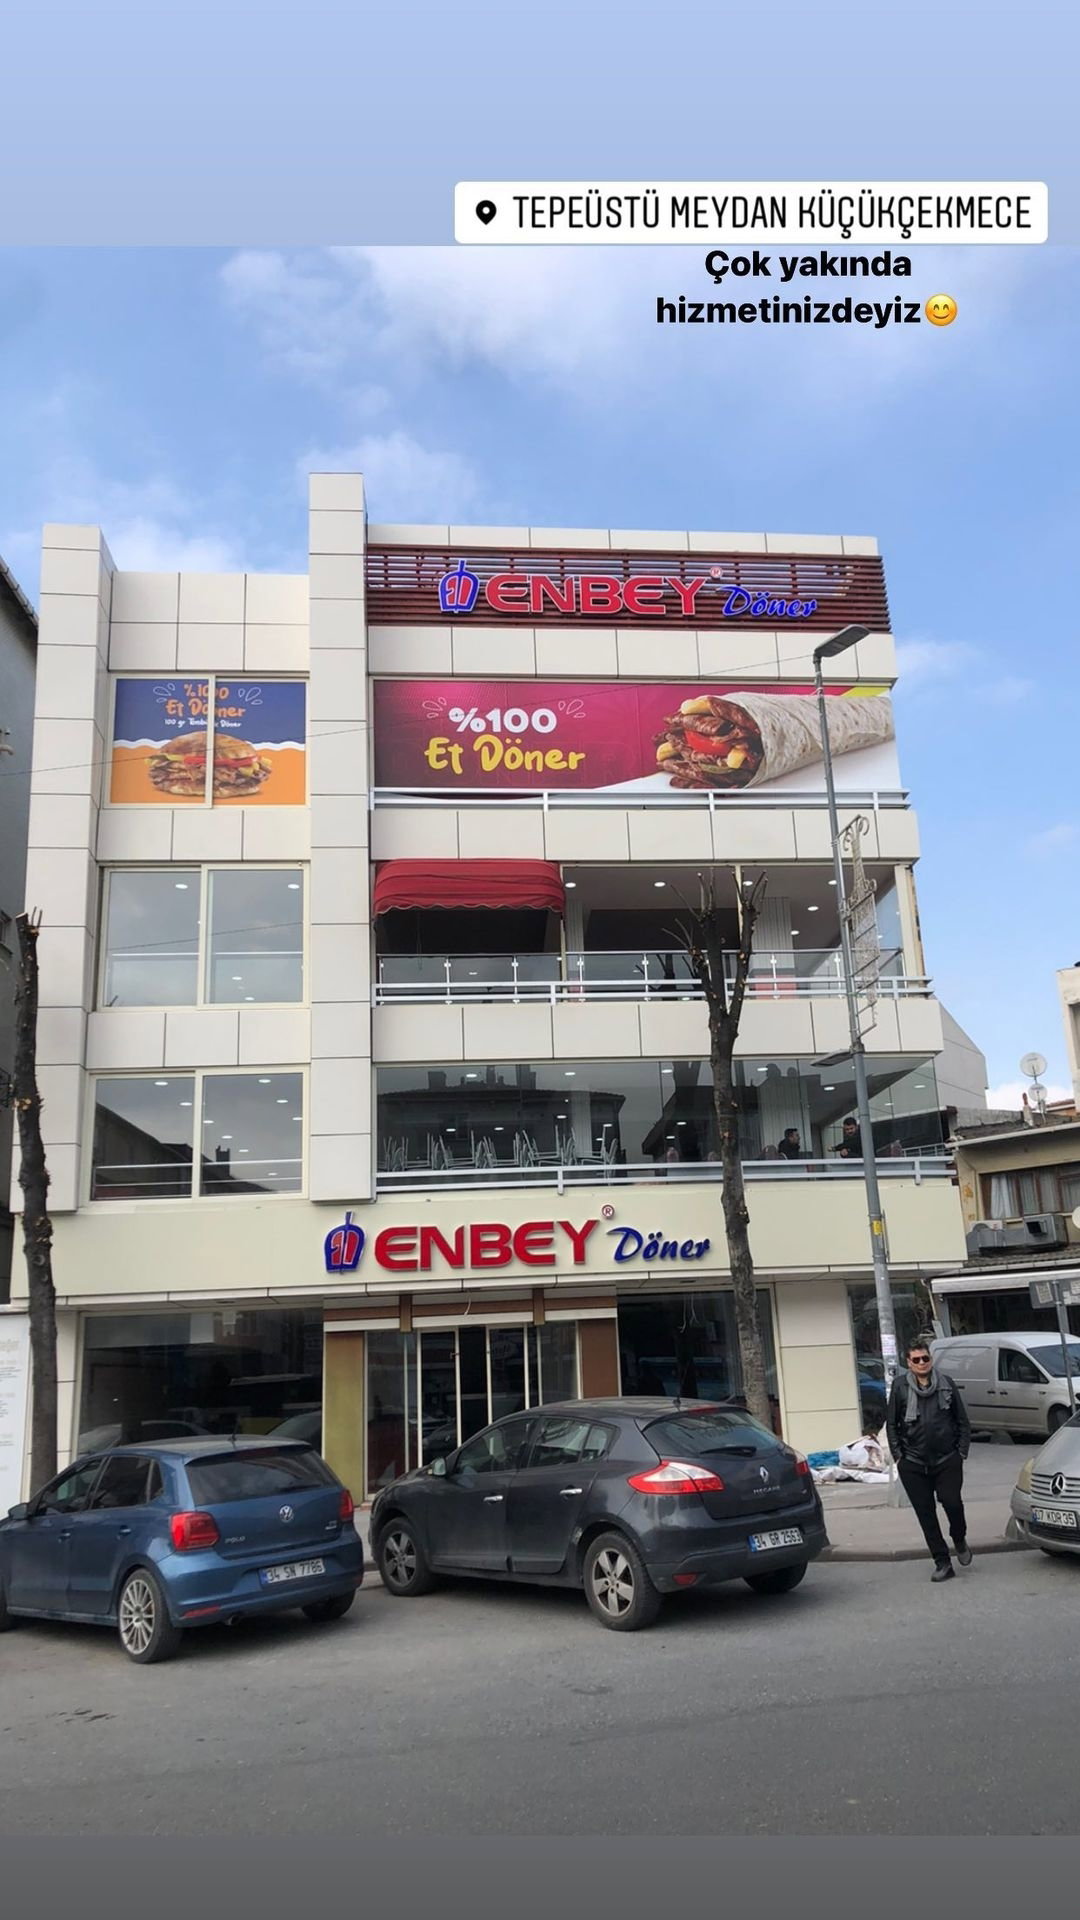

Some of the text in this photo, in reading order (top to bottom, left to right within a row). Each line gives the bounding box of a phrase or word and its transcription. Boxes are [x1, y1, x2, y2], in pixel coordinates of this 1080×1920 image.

[485, 573, 707, 617] ENBEY
[716, 584, 819, 618] Döner
[165, 699, 184, 717] Et
[448, 706, 558, 734] %100
[424, 733, 586, 775] Et Döner
[374, 1219, 599, 1272] ENBEY
[606, 1225, 712, 1264] Döner
[754, 1535, 767, 1548] 34
